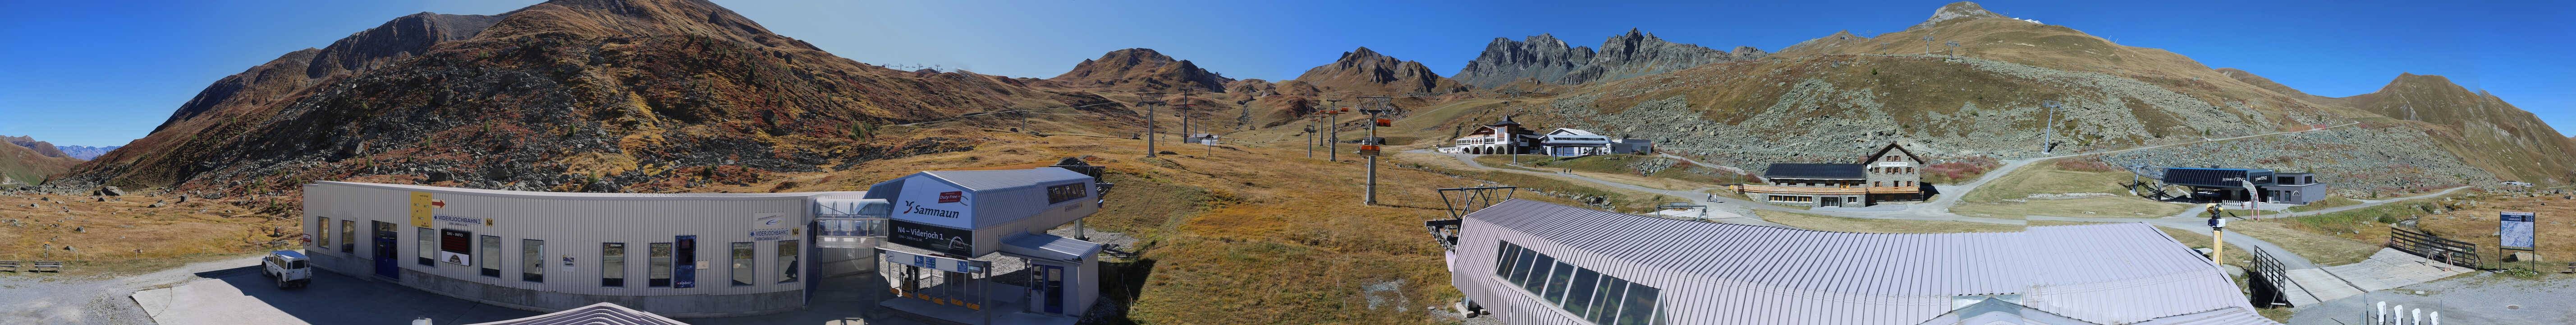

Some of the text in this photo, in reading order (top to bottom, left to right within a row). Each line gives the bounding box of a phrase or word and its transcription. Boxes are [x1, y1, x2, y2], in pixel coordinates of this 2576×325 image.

[914, 205, 959, 219] Samnaun
[438, 216, 477, 224] VIDERJOCHBAHN
[911, 228, 938, 239] Viderjoch
